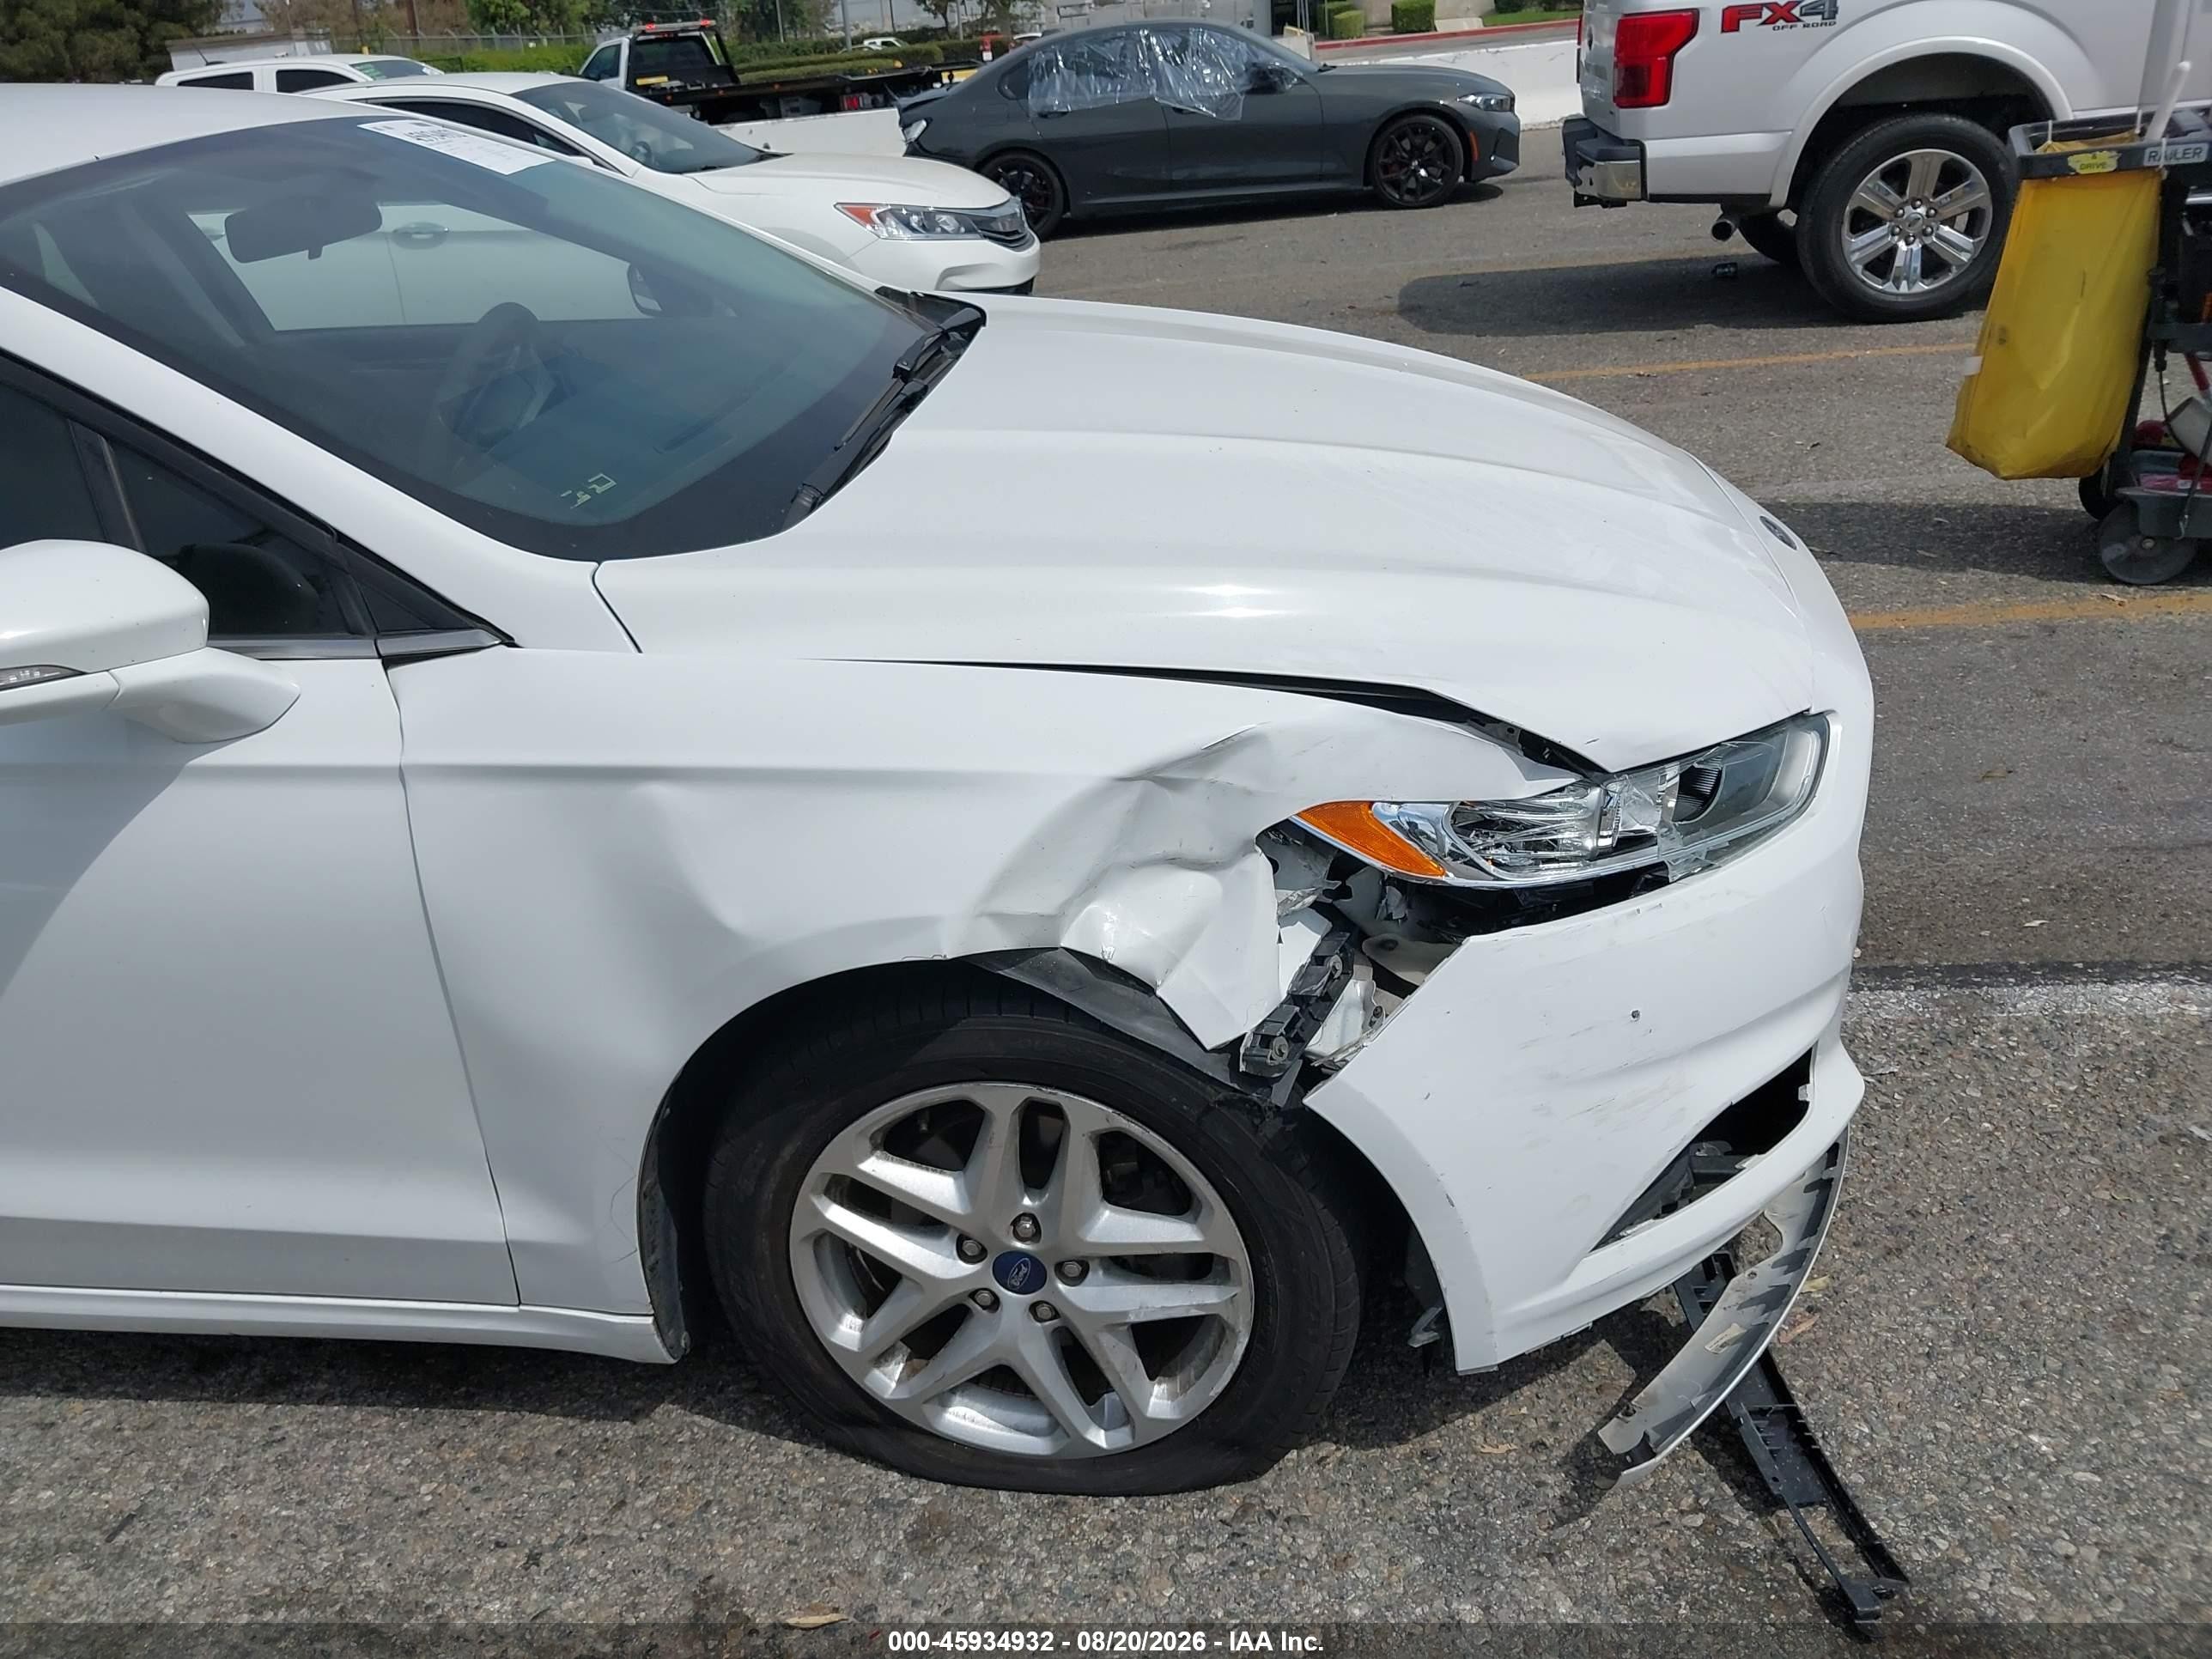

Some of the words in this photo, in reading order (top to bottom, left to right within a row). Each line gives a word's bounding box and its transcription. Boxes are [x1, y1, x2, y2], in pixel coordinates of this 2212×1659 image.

[1720, 0, 1838, 33] FX4
[1771, 23, 1798, 32] OFF
[1802, 20, 1837, 28] ROAD
[1010, 1262, 1029, 1287] Ford
